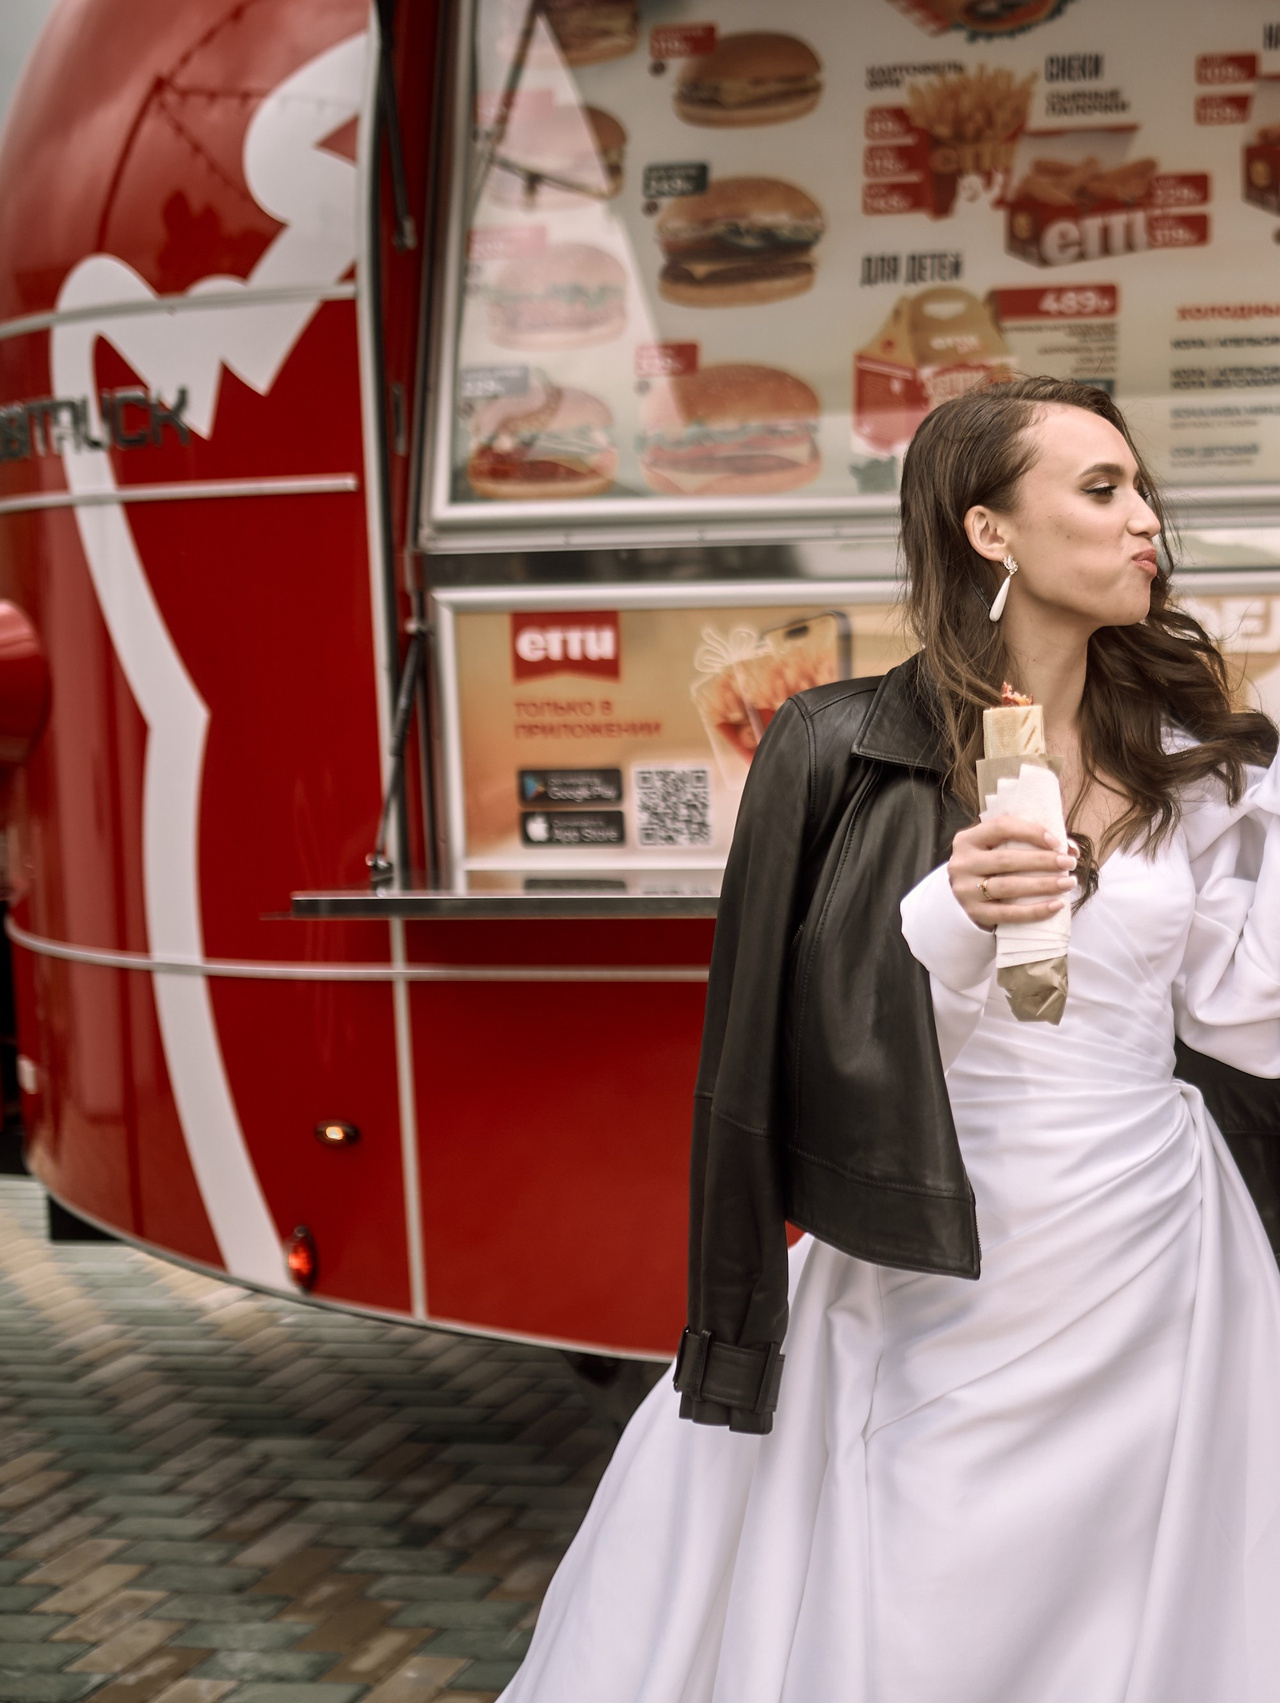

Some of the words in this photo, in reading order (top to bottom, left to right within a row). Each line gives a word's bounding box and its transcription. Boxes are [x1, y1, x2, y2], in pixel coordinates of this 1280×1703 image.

[1045, 54, 1104, 82] СНЕКИ
[860, 255, 900, 286] ДЛЯ
[904, 253, 963, 285] ДЕТЕЙ
[514, 701, 593, 719] ТОЛЬКО
[602, 701, 614, 717] В
[514, 721, 663, 740] ПРИЛОЖЕНИИ
[581, 826, 618, 842] Store
